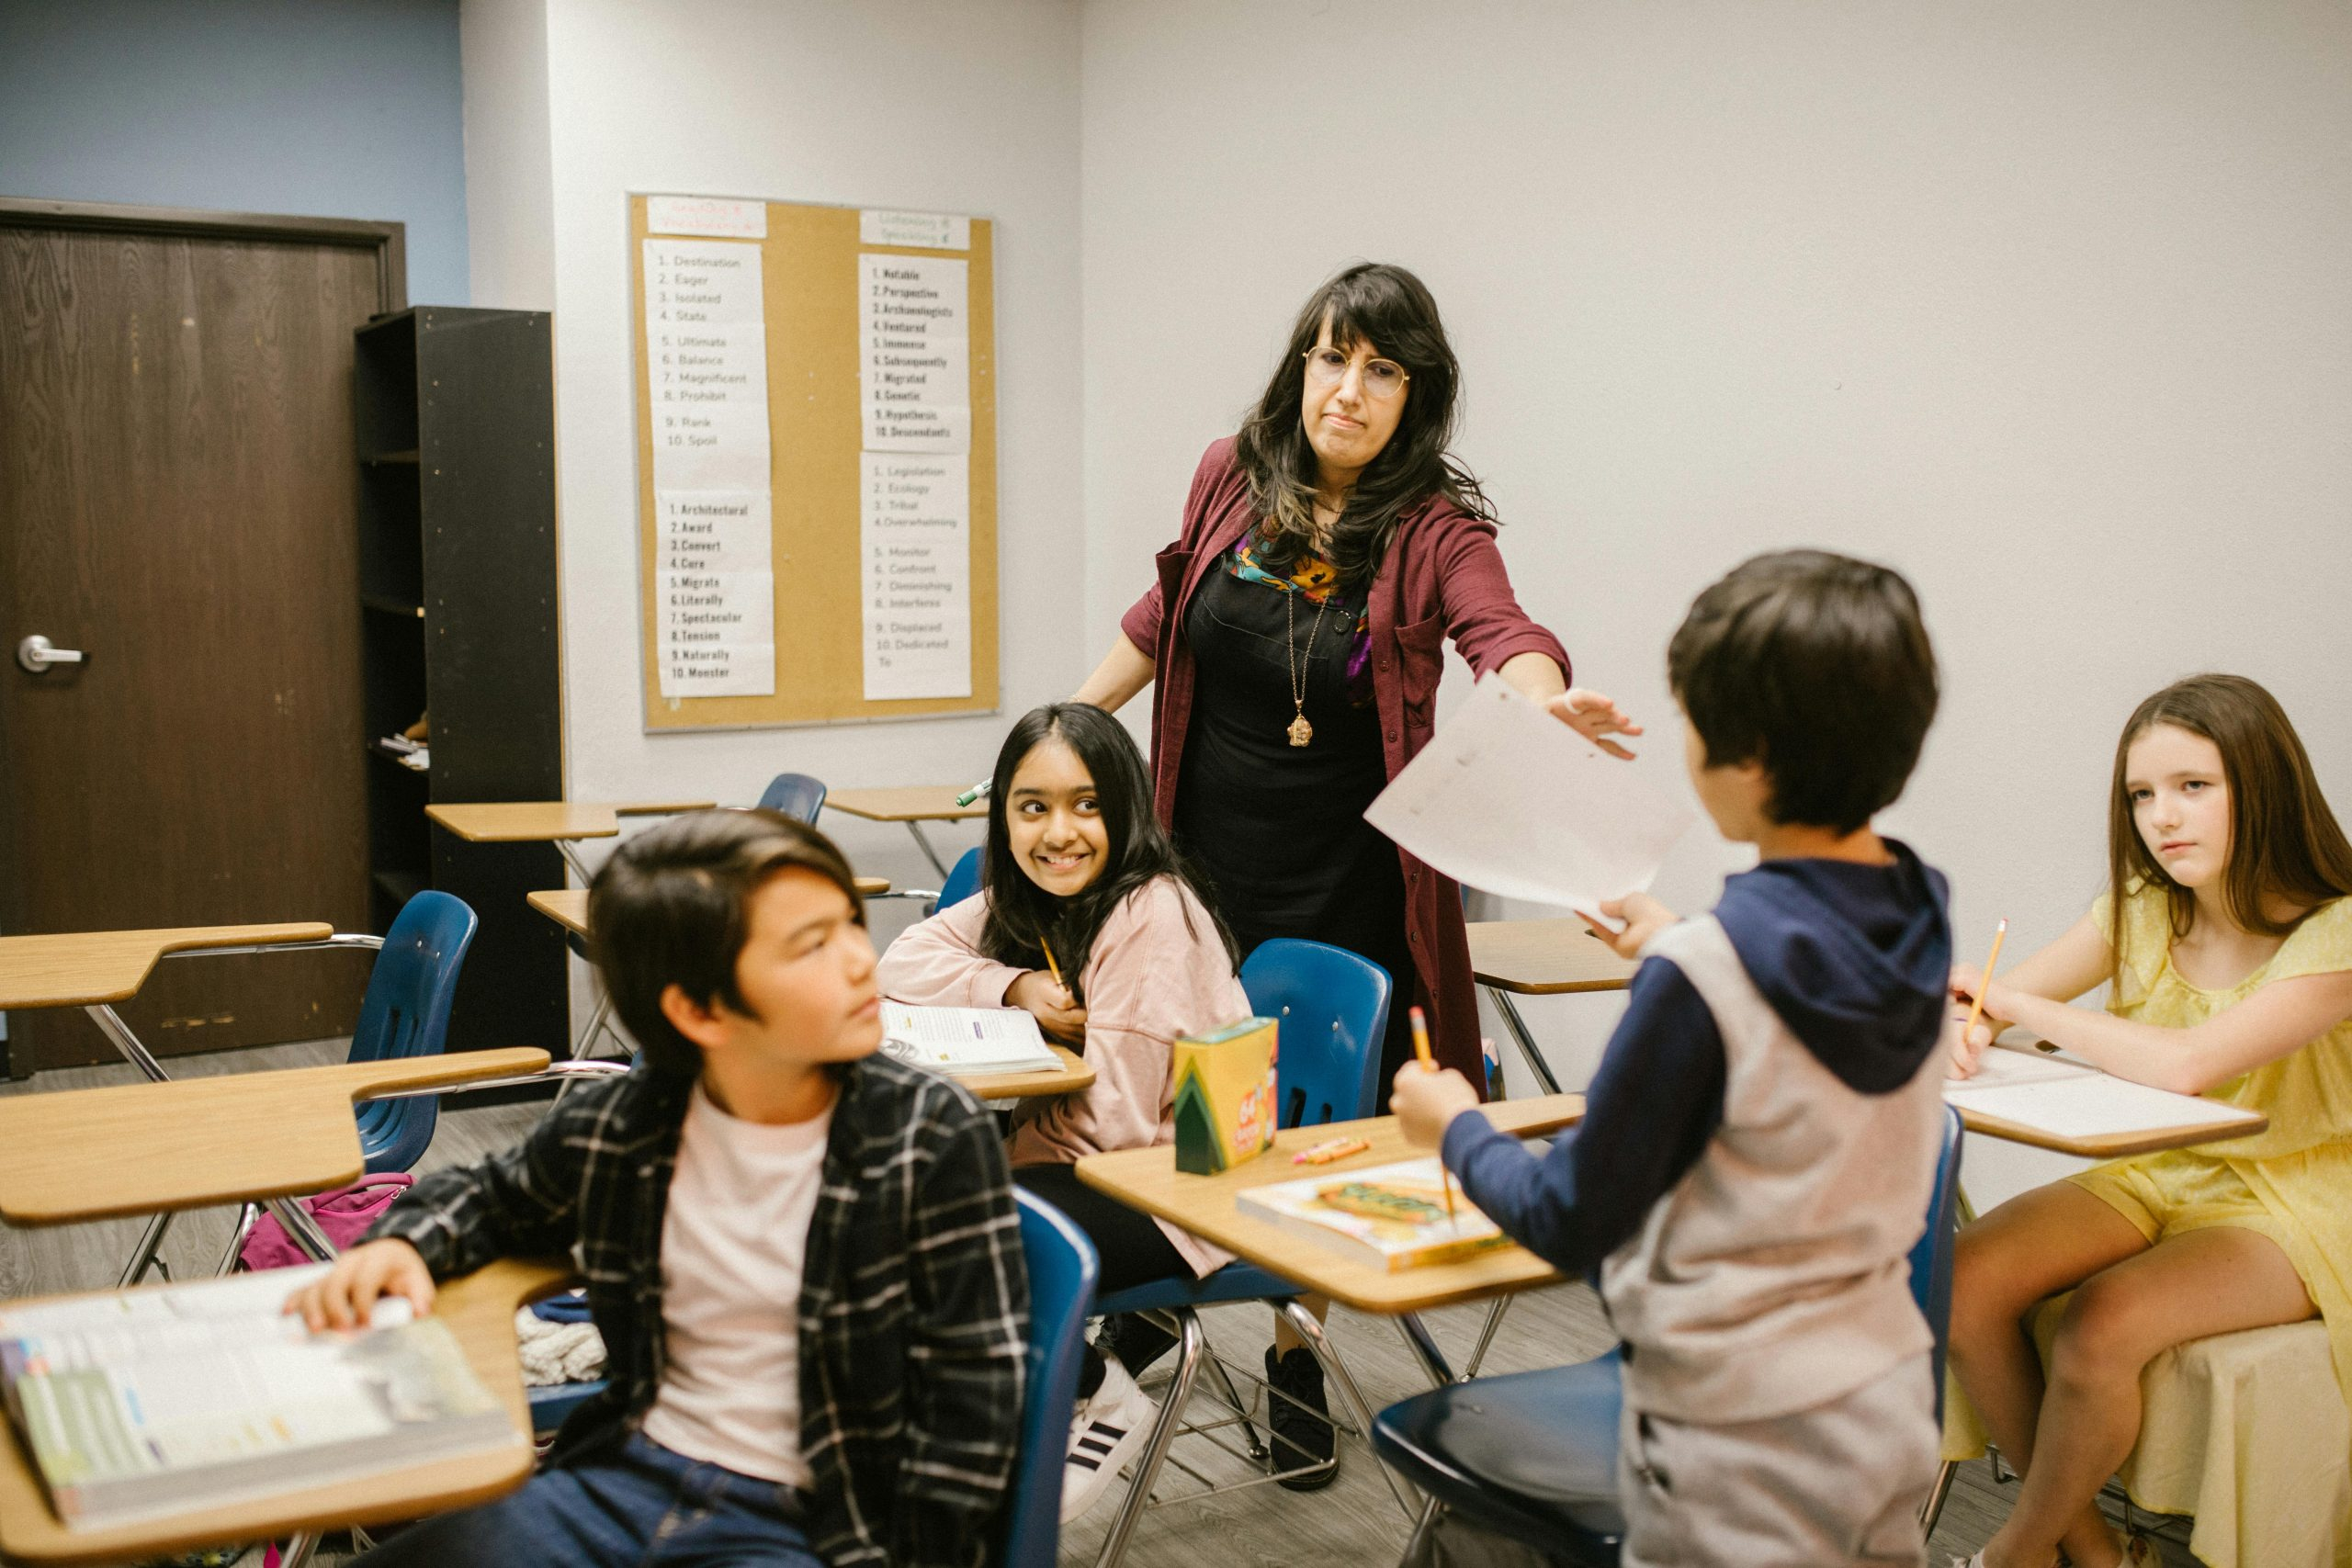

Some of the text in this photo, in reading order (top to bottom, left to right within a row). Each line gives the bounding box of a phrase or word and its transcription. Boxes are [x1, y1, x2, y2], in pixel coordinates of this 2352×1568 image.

[674, 255, 742, 270] Destination
[674, 274, 708, 288] Eager
[675, 294, 722, 304] Isolated
[676, 310, 707, 321] State
[677, 337, 727, 347] Ultimate
[679, 354, 724, 366] Balance
[679, 373, 747, 385] Magnificent
[680, 390, 727, 401] Prohibit
[682, 417, 711, 427] Rank
[688, 435, 718, 447] Spoil
[682, 504, 748, 516] Architectural
[682, 523, 712, 533] Award
[682, 539, 720, 551] Convert
[682, 577, 719, 590] Migrate
[681, 594, 723, 606] Literally
[682, 612, 741, 626] Spectacular
[682, 630, 720, 641] Tension
[683, 650, 729, 661] Naturally
